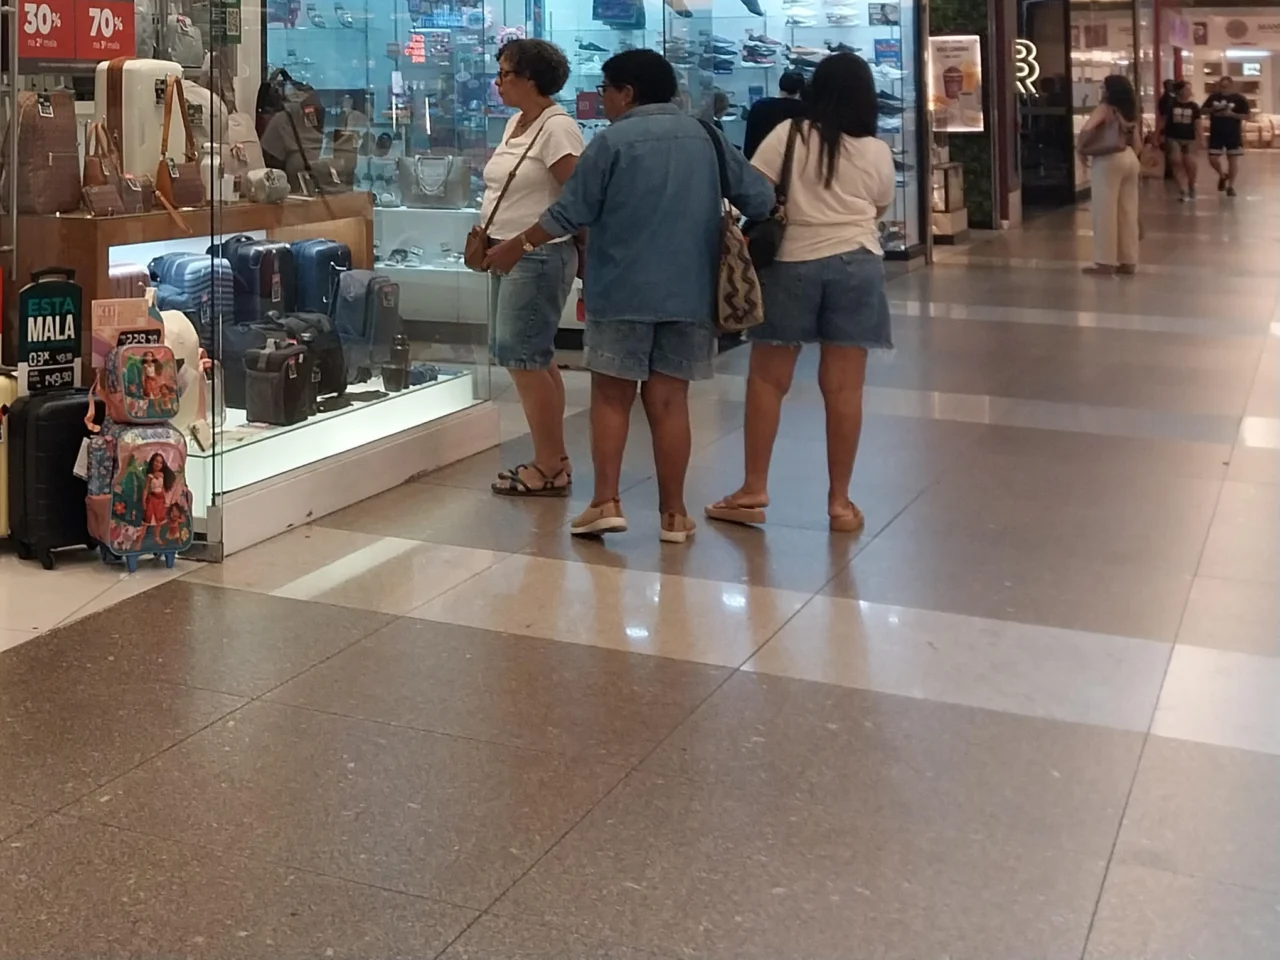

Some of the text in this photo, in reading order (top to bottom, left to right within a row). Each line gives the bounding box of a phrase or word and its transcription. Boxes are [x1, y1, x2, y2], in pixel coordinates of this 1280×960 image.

[24, 3, 61, 35] 30%
[89, 7, 123, 38] 70%
[28, 297, 75, 316] ESTA
[27, 314, 75, 343] MALA
